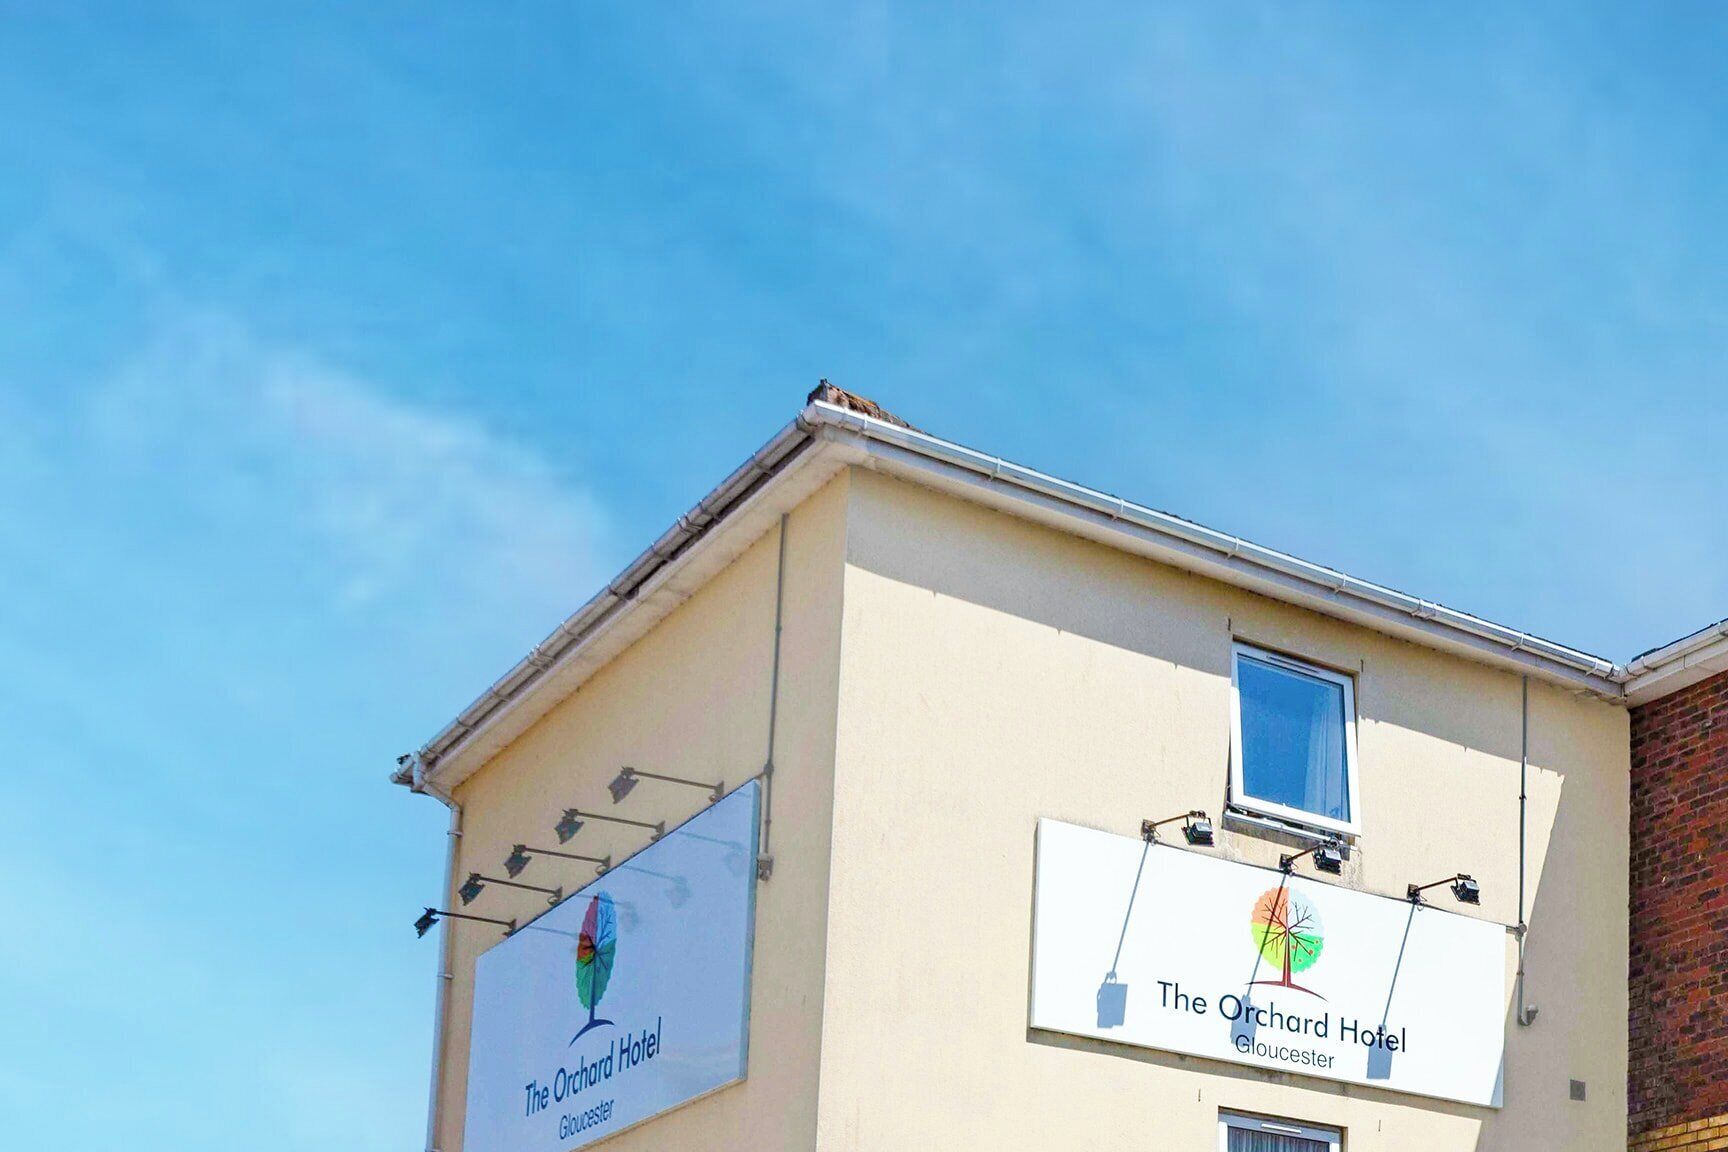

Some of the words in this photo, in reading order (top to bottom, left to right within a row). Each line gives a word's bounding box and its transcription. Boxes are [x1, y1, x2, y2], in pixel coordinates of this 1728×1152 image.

[1157, 981, 1207, 1014] The
[1219, 994, 1328, 1039] Orchard
[1341, 1017, 1406, 1053] Hotel
[525, 1080, 550, 1117] The
[553, 1040, 614, 1103] Orchard
[618, 1016, 662, 1073] Hotel
[1235, 1034, 1335, 1069] Gloucester
[559, 1099, 615, 1140] Gloucester
